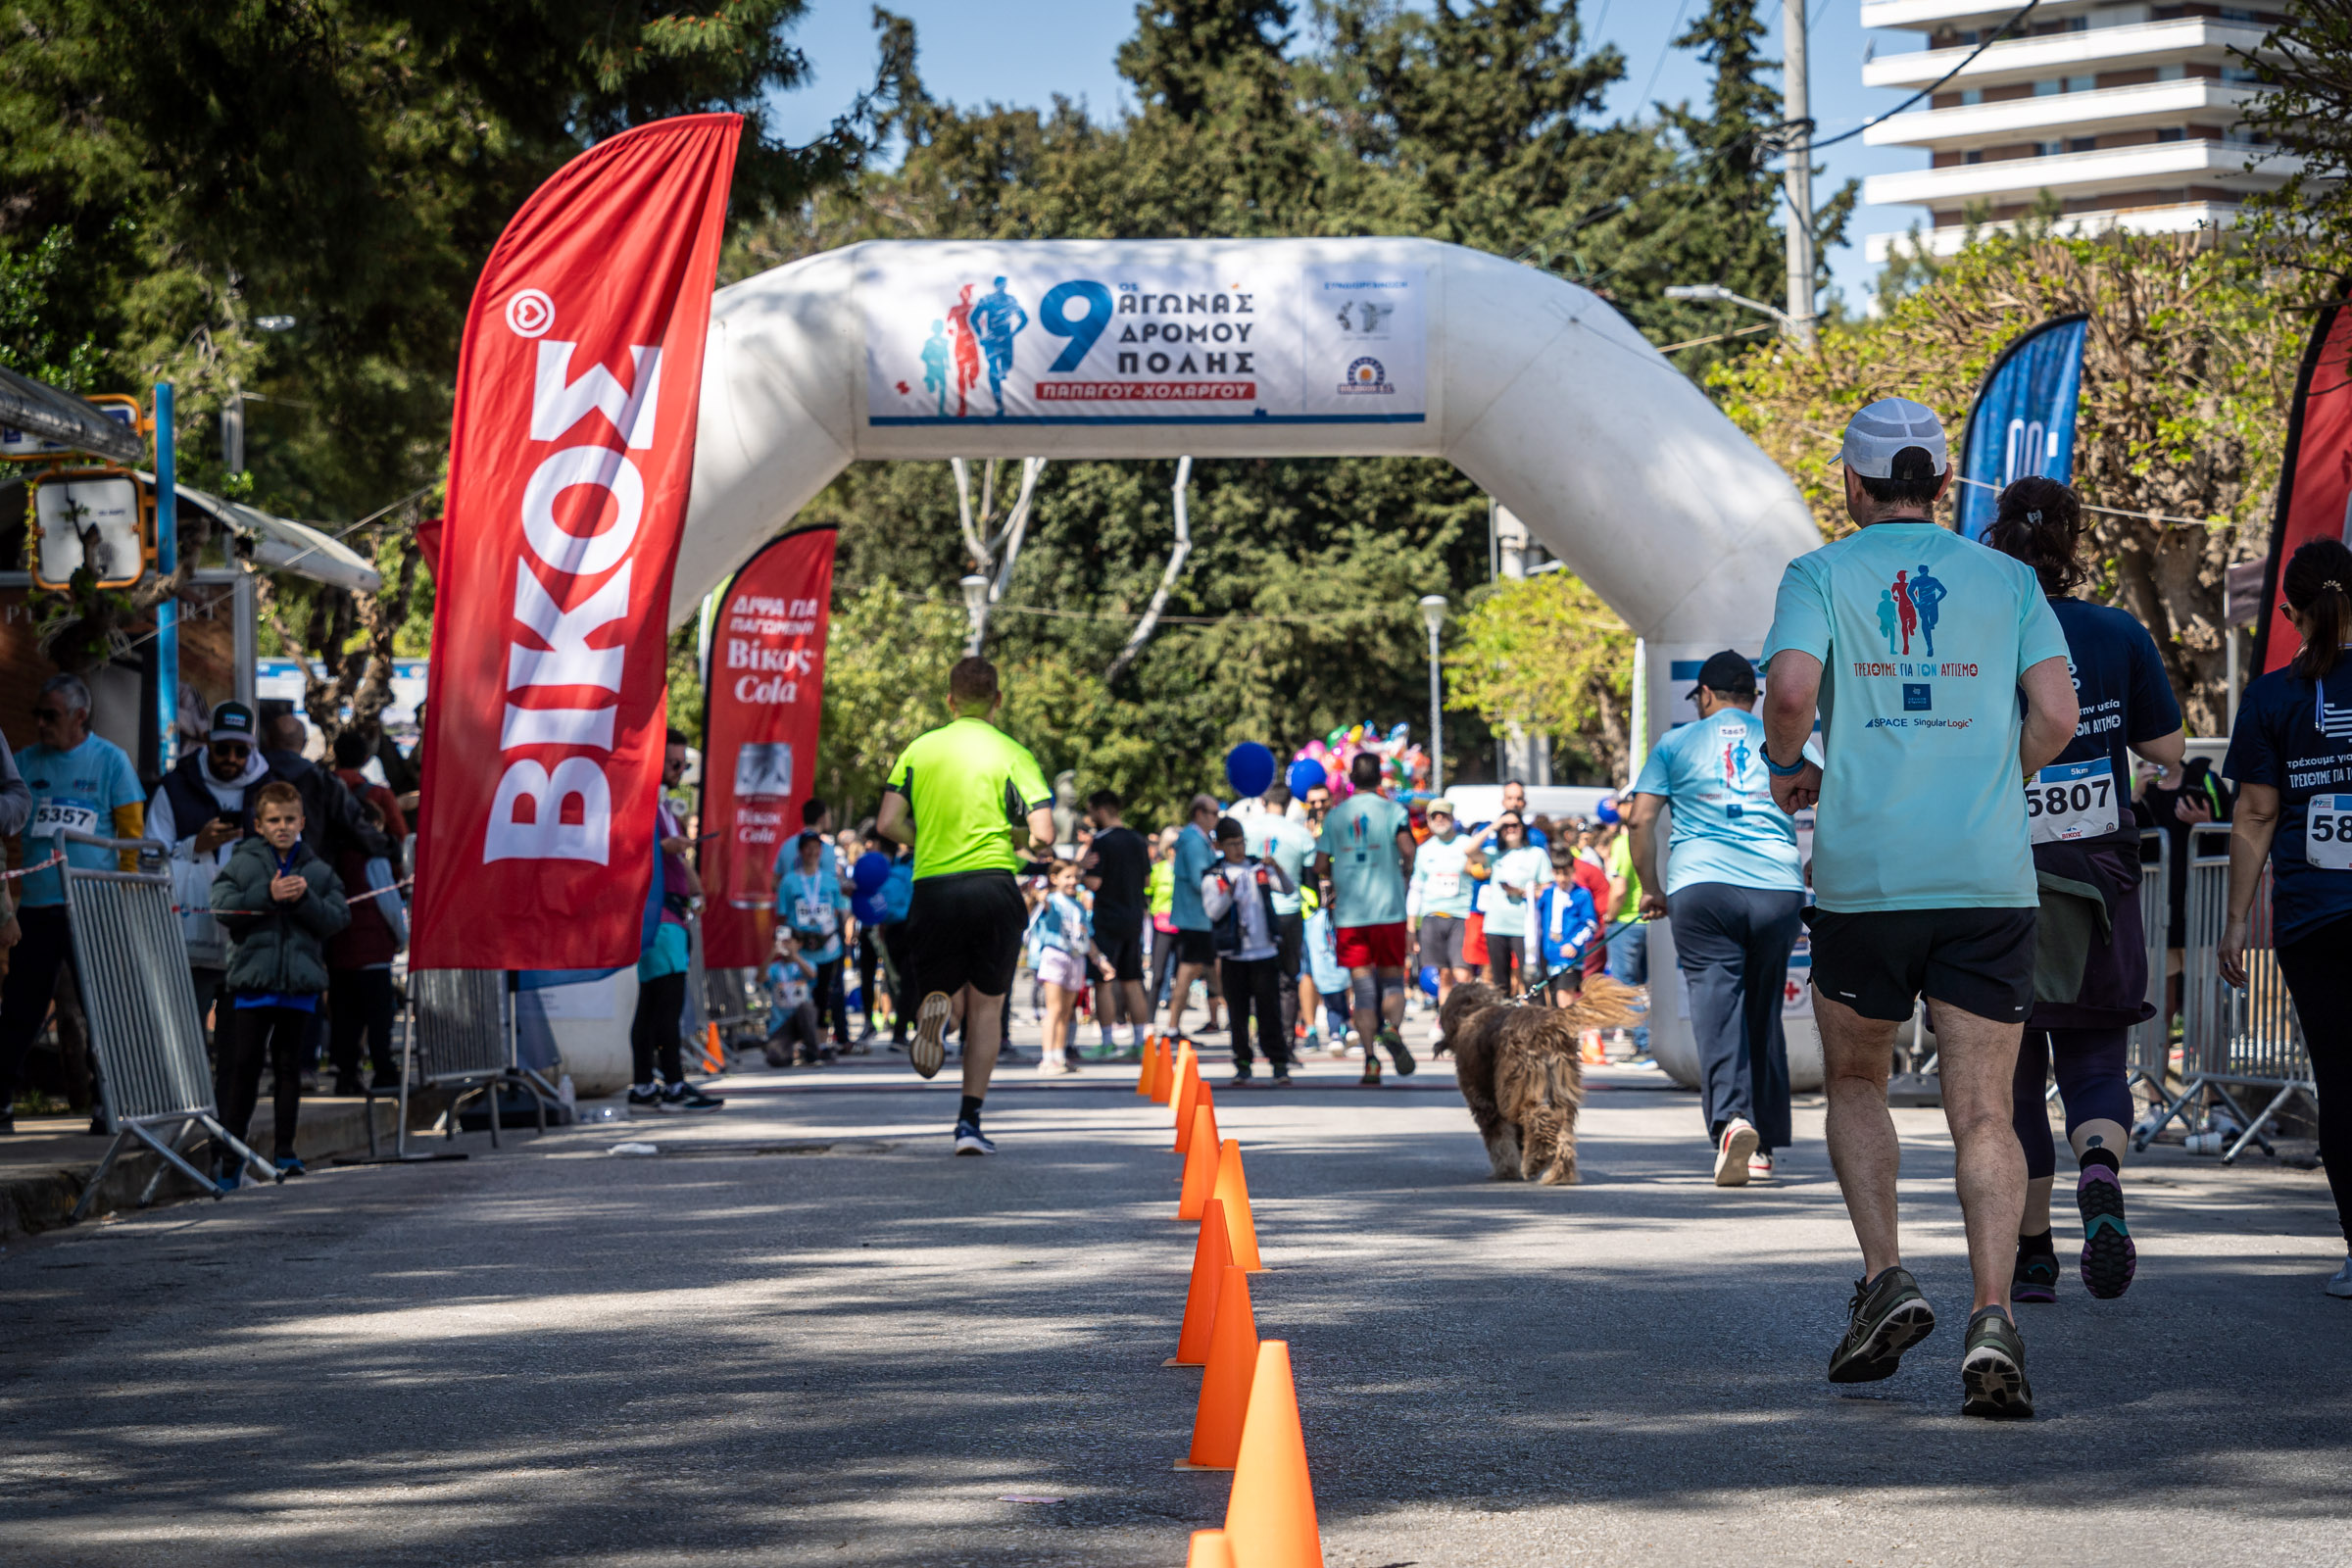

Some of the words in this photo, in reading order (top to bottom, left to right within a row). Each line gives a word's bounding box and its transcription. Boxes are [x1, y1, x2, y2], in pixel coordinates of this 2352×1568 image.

[1118, 294, 1253, 314] ΑΓΩΝΑΣ
[1040, 280, 1113, 372] 9
[1118, 322, 1253, 343] ΔΡΟΜΟΥ
[1118, 352, 1254, 374] ΠΟΛΗΣ
[1042, 383, 1249, 398] ΠΑΠΑΓΟΥ-ΧΟΛΑΡΓΟΥ
[482, 339, 662, 866] ΒΙΚΟΣ
[727, 638, 811, 675] Βίκος
[1853, 662, 1897, 677] ΤΡΕΧΟΥΜΕ
[1900, 663, 1913, 676] ΓΙΑ
[1917, 662, 1937, 677] ΤΟΝ
[1940, 662, 1979, 677] ΑΥΤΙΣΜΟ
[734, 674, 798, 704] Cola
[2097, 699, 2121, 711] υεία
[1874, 718, 1908, 728] SPACE
[2073, 720, 2090, 738] ΟΝ
[2286, 756, 2335, 769] τρέχουμε
[2337, 754, 2352, 763] για
[2289, 770, 2331, 788] ΤΡΕΧΟΥΜΕ
[2332, 768, 2344, 782] ΓΙΑ
[2025, 779, 2111, 817] 5807
[37, 807, 91, 826] 5357
[2061, 830, 2082, 840] ΒΙΚΟΣ
